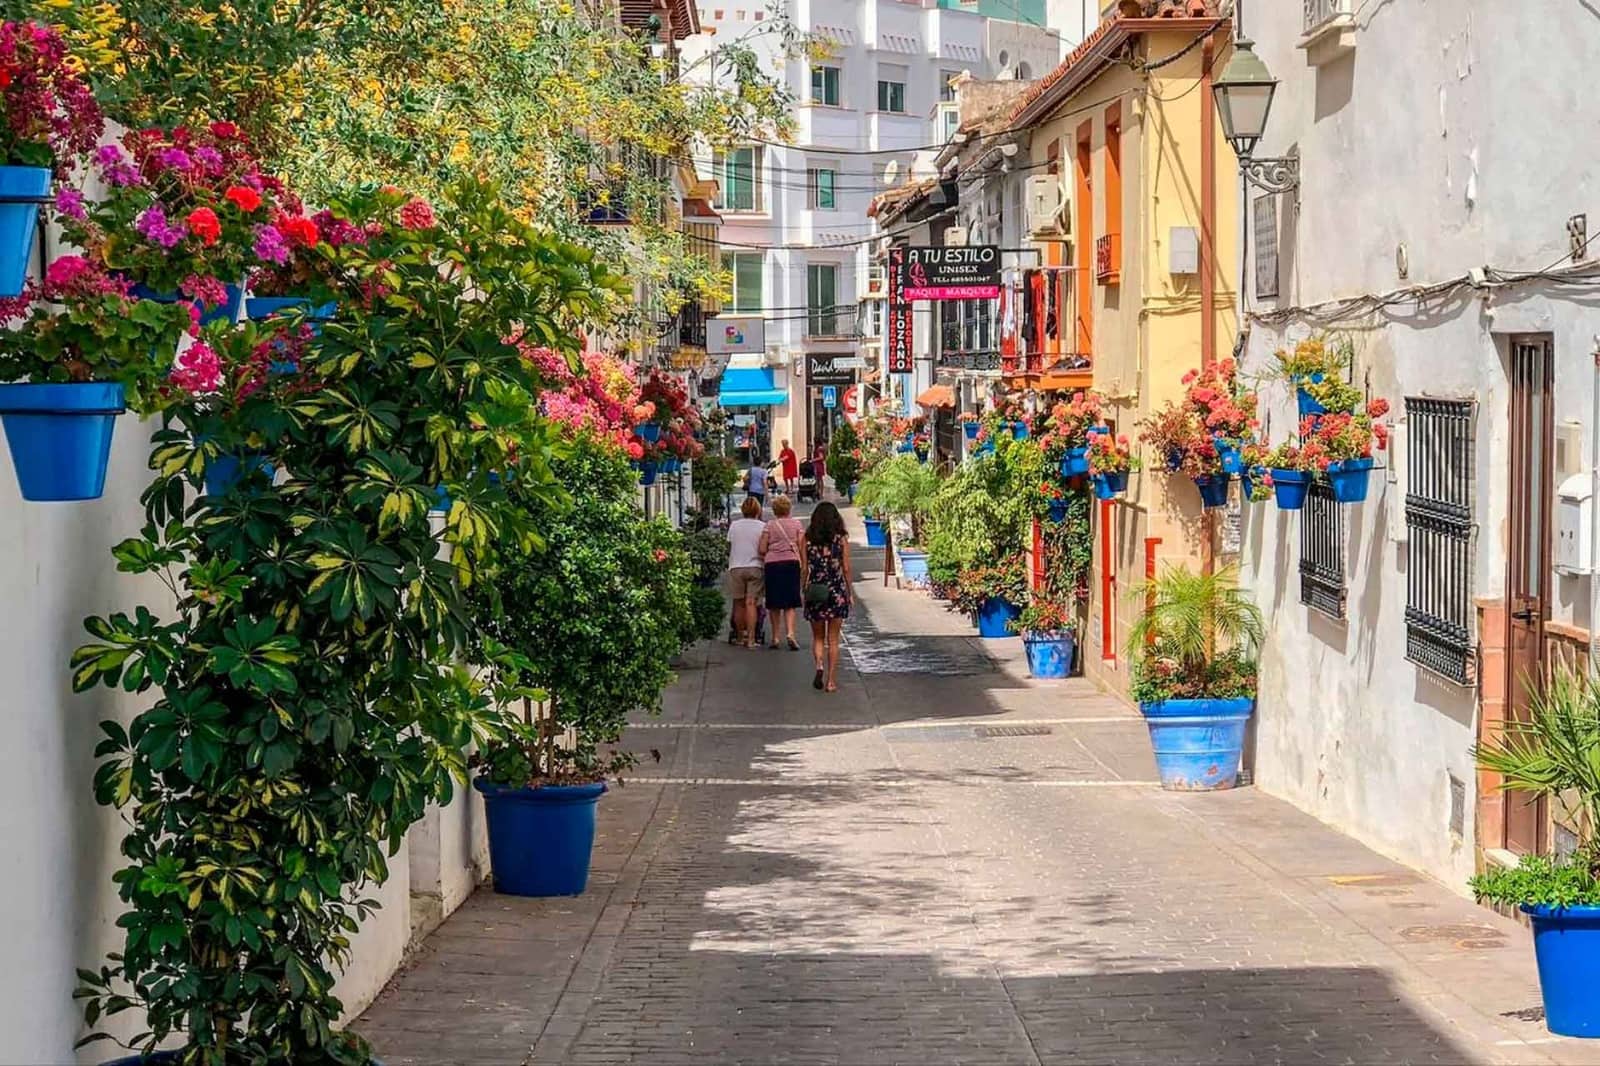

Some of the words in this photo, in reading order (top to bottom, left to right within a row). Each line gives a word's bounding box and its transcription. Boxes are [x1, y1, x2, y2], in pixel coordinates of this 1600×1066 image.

[908, 249, 919, 263] A
[923, 248, 941, 264] TU
[944, 248, 994, 263] ESTILO
[938, 265, 979, 274] UNISEX
[909, 288, 939, 298] PAQUI
[897, 310, 905, 369] LOZANO
